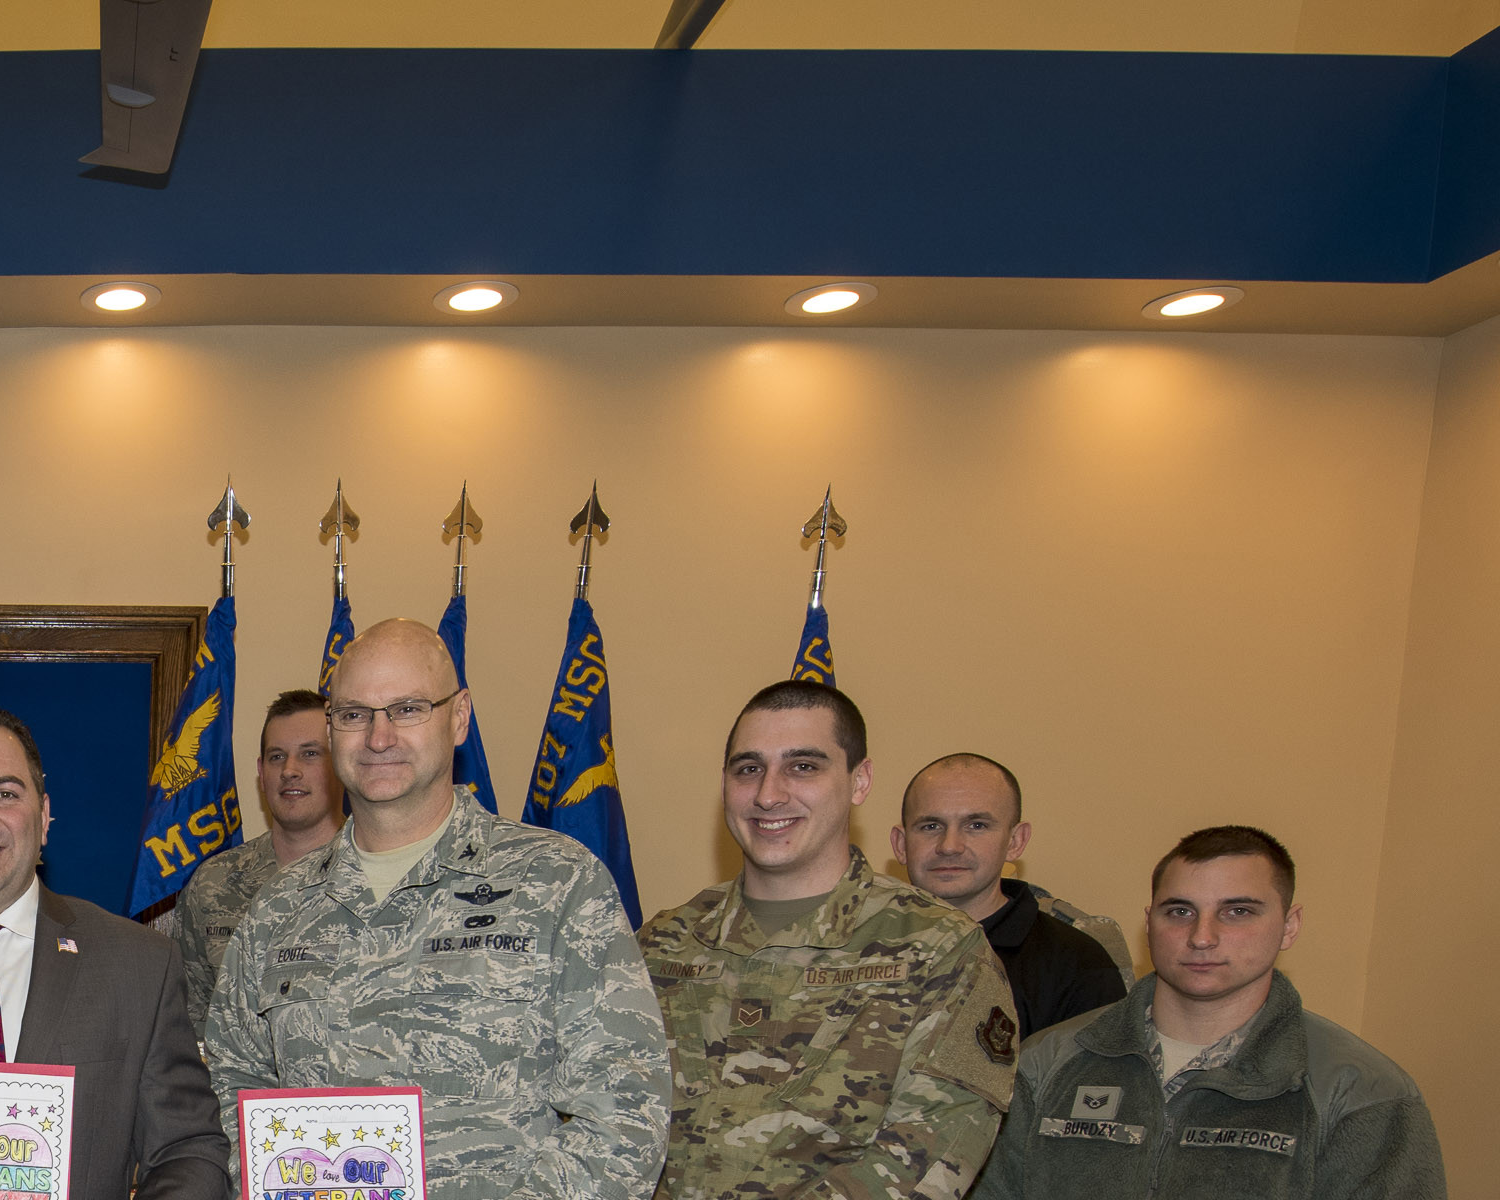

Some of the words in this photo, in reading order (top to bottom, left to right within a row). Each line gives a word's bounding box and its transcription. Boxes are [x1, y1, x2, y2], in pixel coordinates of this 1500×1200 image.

[534, 732, 566, 810] 107
[145, 786, 241, 878] MSG
[431, 938, 455, 952] U.S.
[460, 935, 481, 949] AIR
[485, 934, 530, 953] FORCE
[660, 962, 705, 977] KINNEY
[832, 969, 853, 984] AIR
[857, 964, 901, 980] FORCE
[1064, 1122, 1117, 1137] BURDZY
[1185, 1130, 1210, 1143] U.S.
[1215, 1131, 1236, 1144] AIR
[1240, 1132, 1290, 1151] FORCE
[277, 1157, 317, 1185] We
[322, 1169, 340, 1183] love
